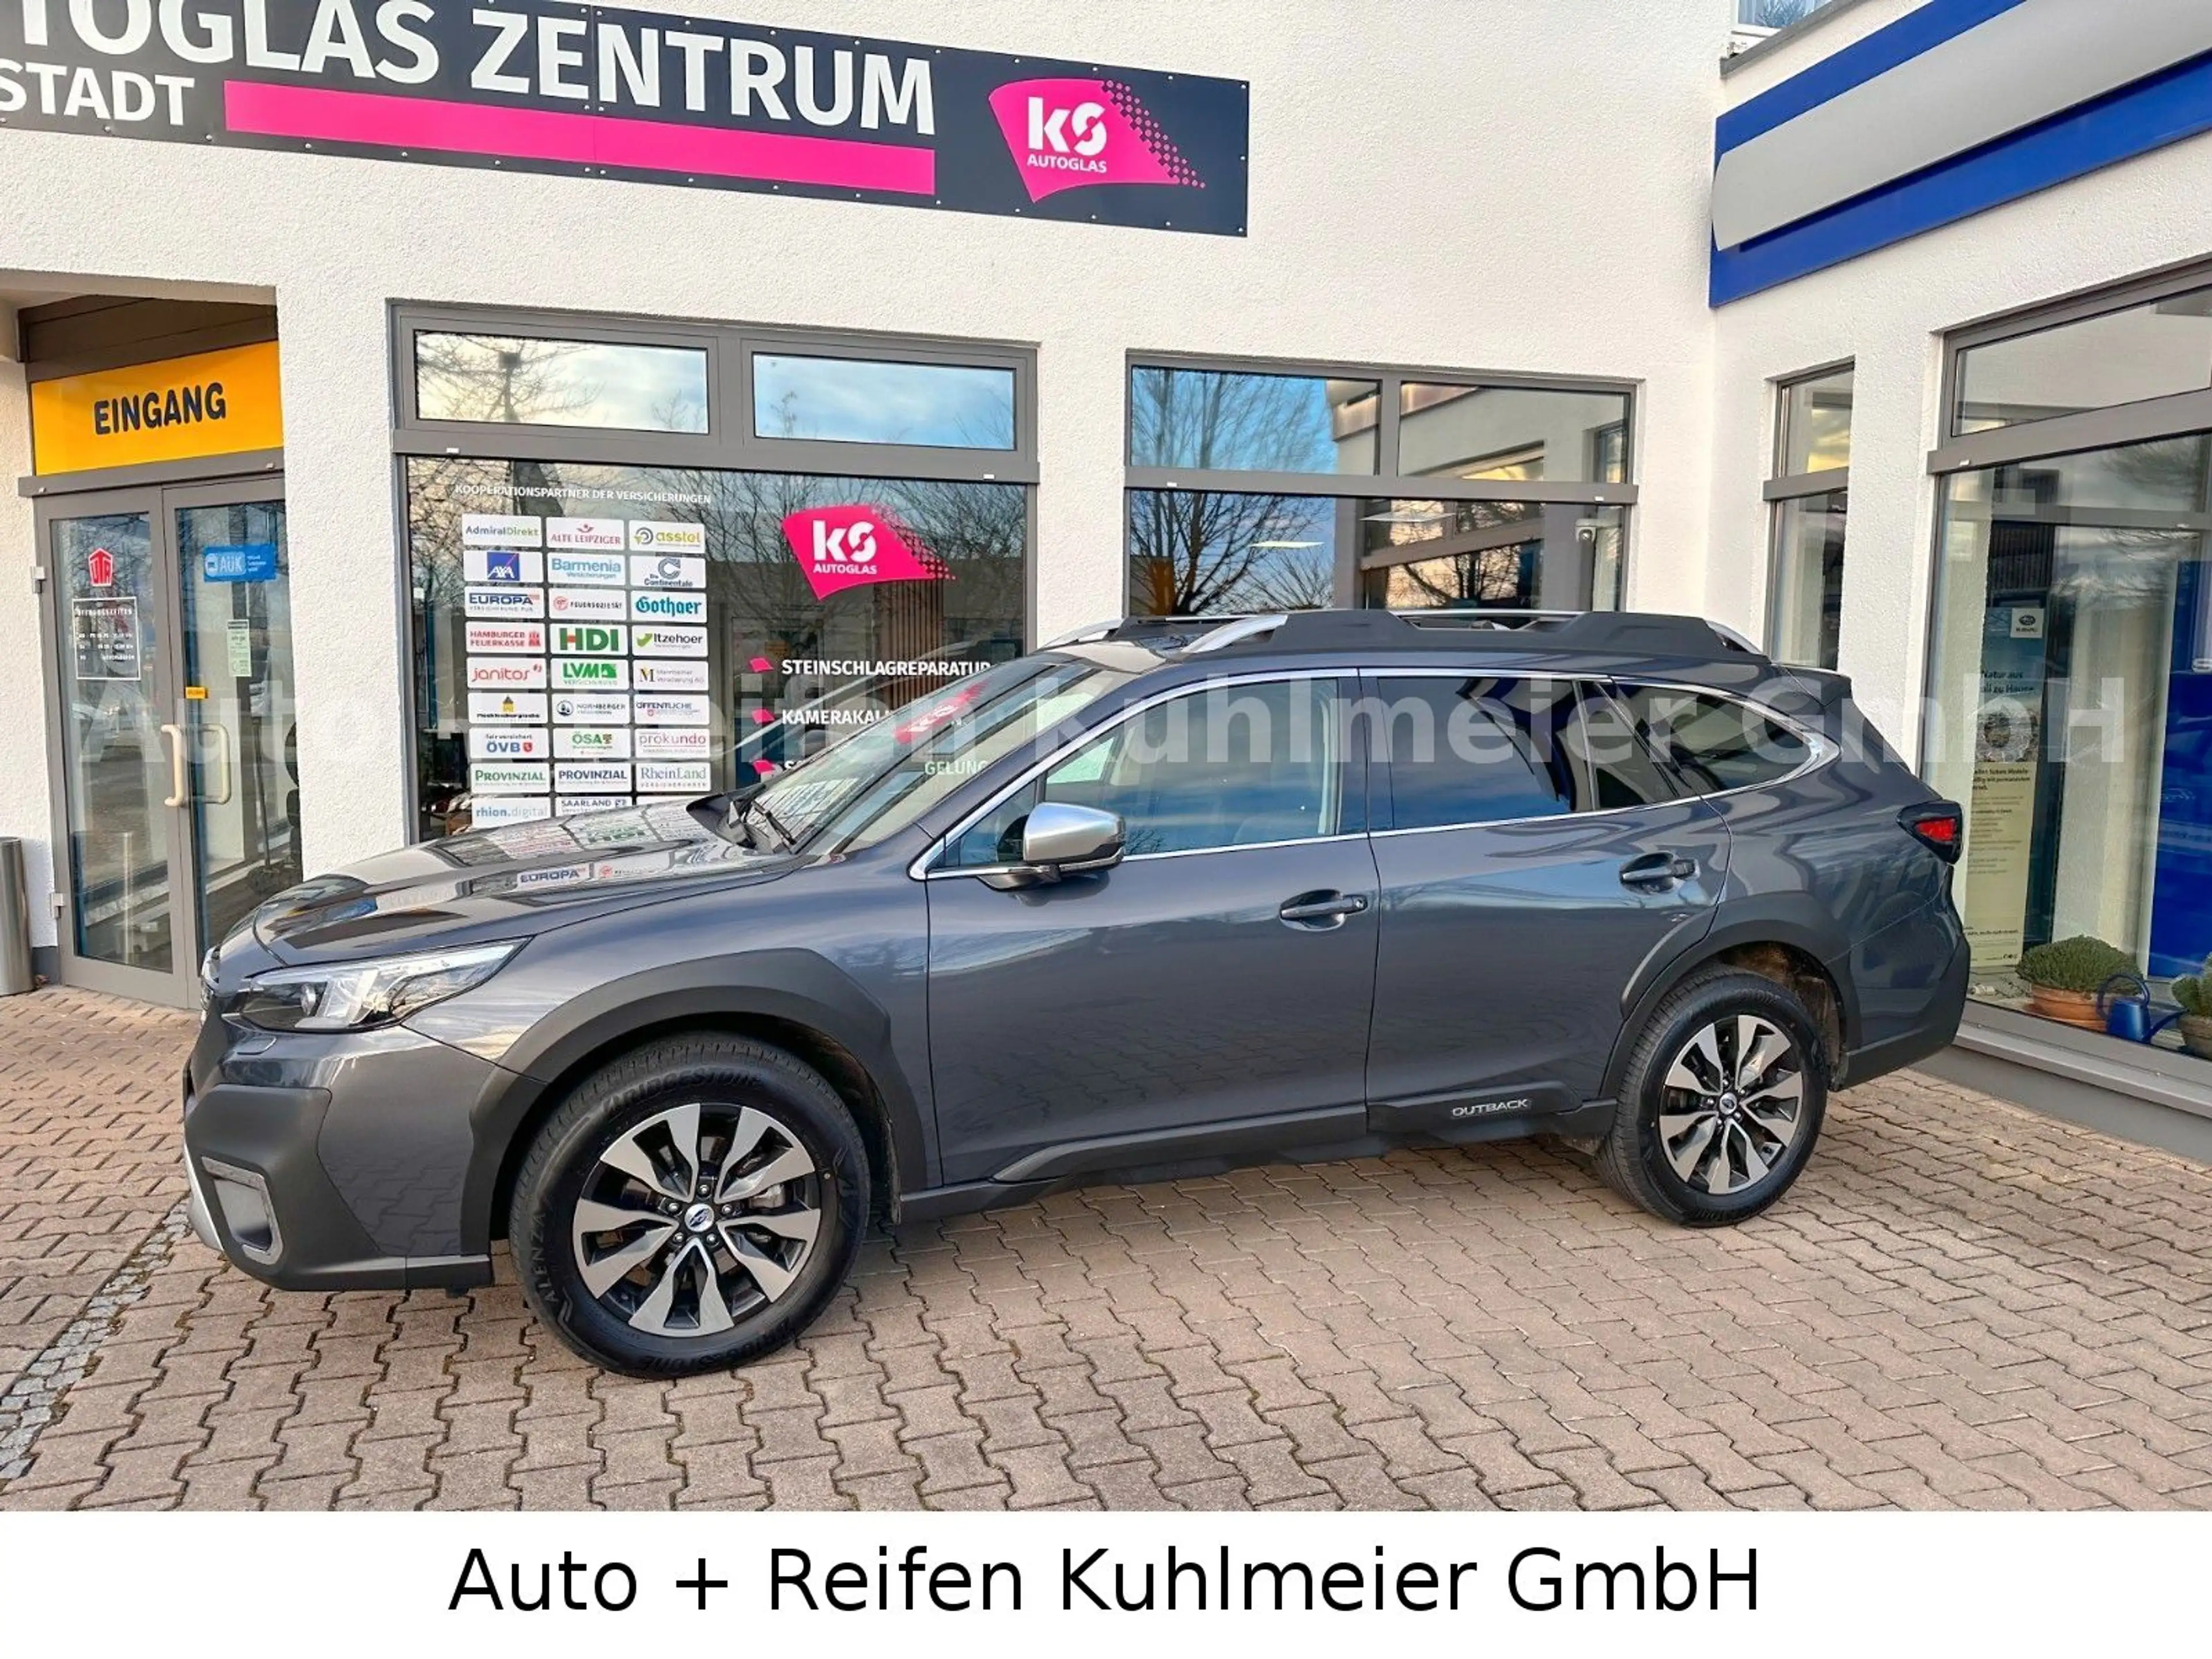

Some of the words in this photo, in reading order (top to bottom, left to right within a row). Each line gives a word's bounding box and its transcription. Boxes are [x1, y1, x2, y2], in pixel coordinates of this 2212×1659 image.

[471, 8, 935, 136] ZENTRUM
[1027, 154, 1107, 173] AUTOGLAS
[94, 382, 226, 435] EINGANG
[455, 486, 589, 499] KOOPERATIONSPARTNER
[592, 490, 614, 499] DER
[616, 491, 711, 505] VERSICHERUNGEN
[465, 525, 540, 536] AdmiralDirekt
[551, 534, 572, 542] ALTE
[574, 535, 621, 544] LEIPZIGER
[551, 558, 621, 572] Barmenia
[813, 563, 877, 575] AUTOGLAS
[487, 565, 516, 579] AXA
[469, 593, 533, 605] EUROPA
[635, 596, 702, 617] Gothaer
[469, 639, 525, 647] FEUERKASSE
[559, 627, 619, 652] HDI
[654, 633, 703, 644] Itzehoer
[471, 668, 530, 682] janitos
[563, 662, 599, 678] LVM
[571, 731, 603, 744] ÖSA
[639, 732, 706, 745] prokundo
[486, 740, 520, 753] ÖVB
[558, 770, 627, 779] PROVINZIAL
[561, 799, 611, 807] SAARLAND
[476, 806, 547, 818] rhion.digital
[1451, 1099, 1529, 1118] OUTBACK
